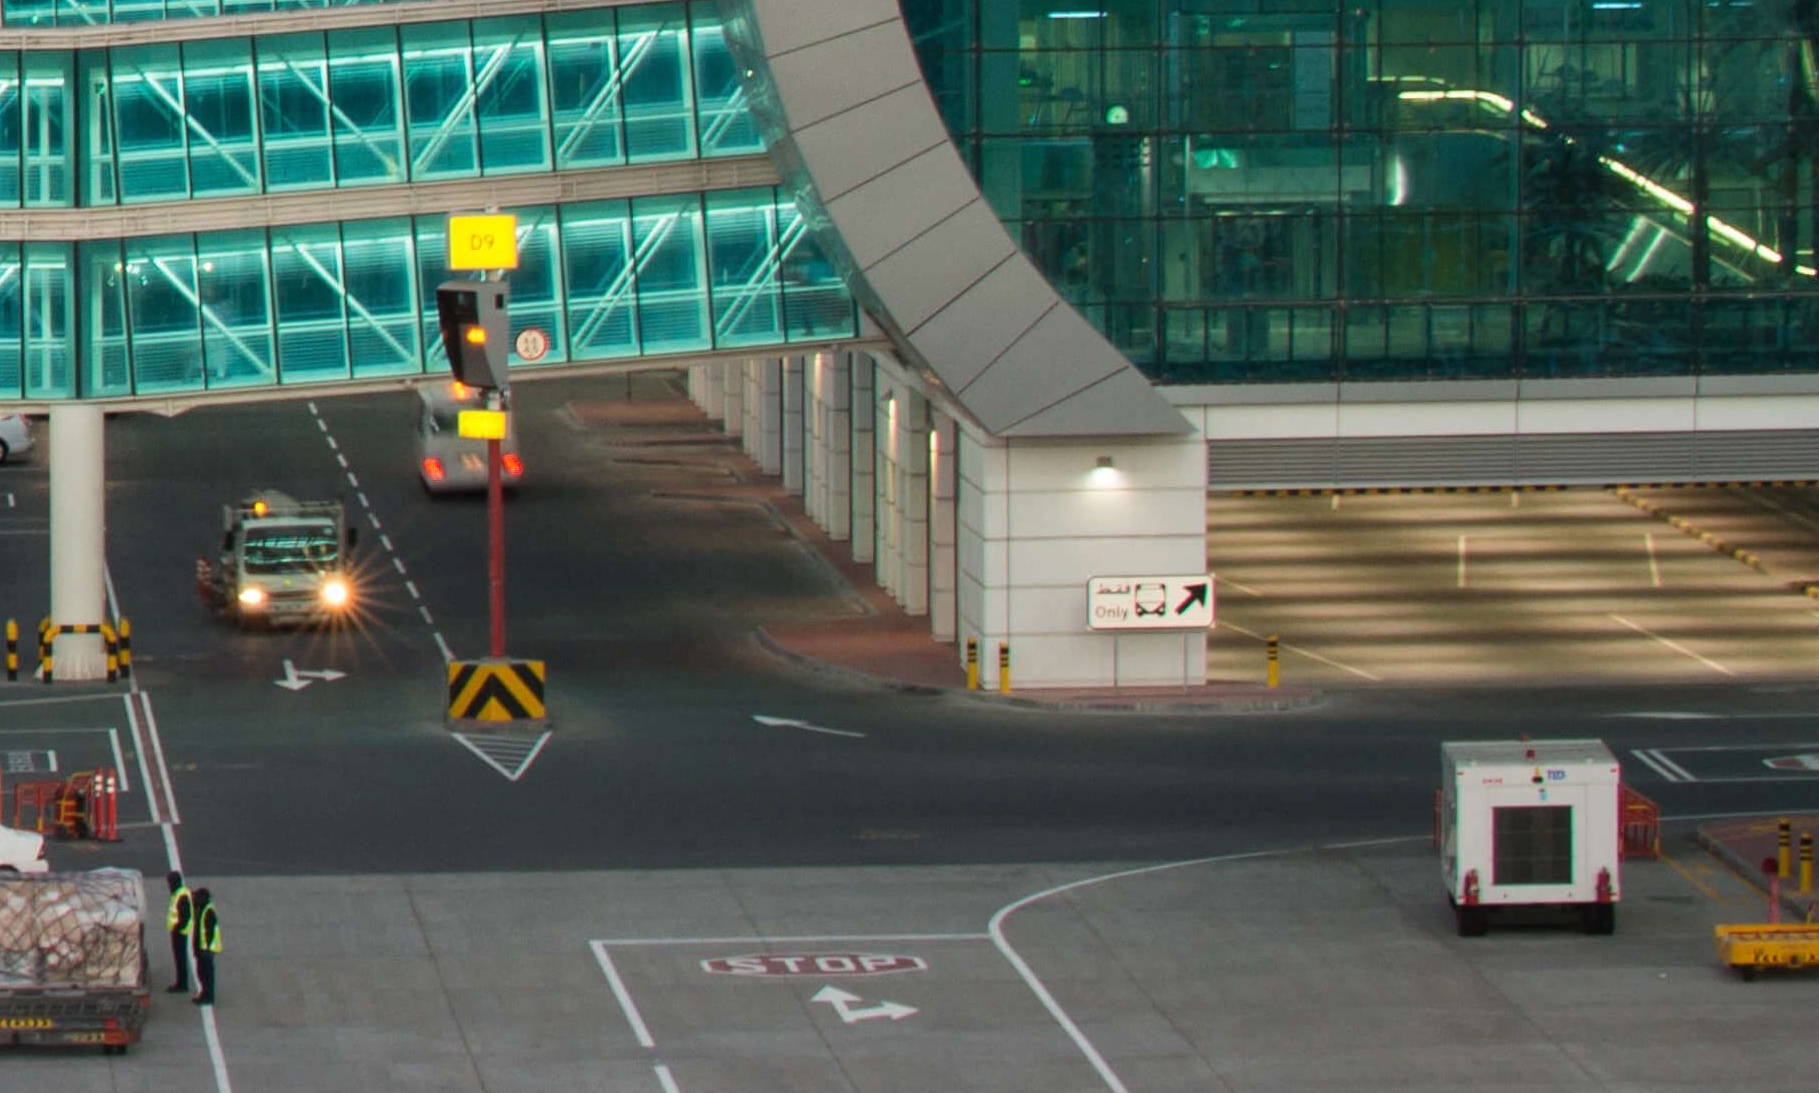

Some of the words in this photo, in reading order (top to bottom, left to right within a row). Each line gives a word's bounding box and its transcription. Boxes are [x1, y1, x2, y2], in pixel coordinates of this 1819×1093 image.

[470, 234, 495, 251] D9
[1095, 604, 1129, 621] Only
[723, 954, 901, 975] STOP
